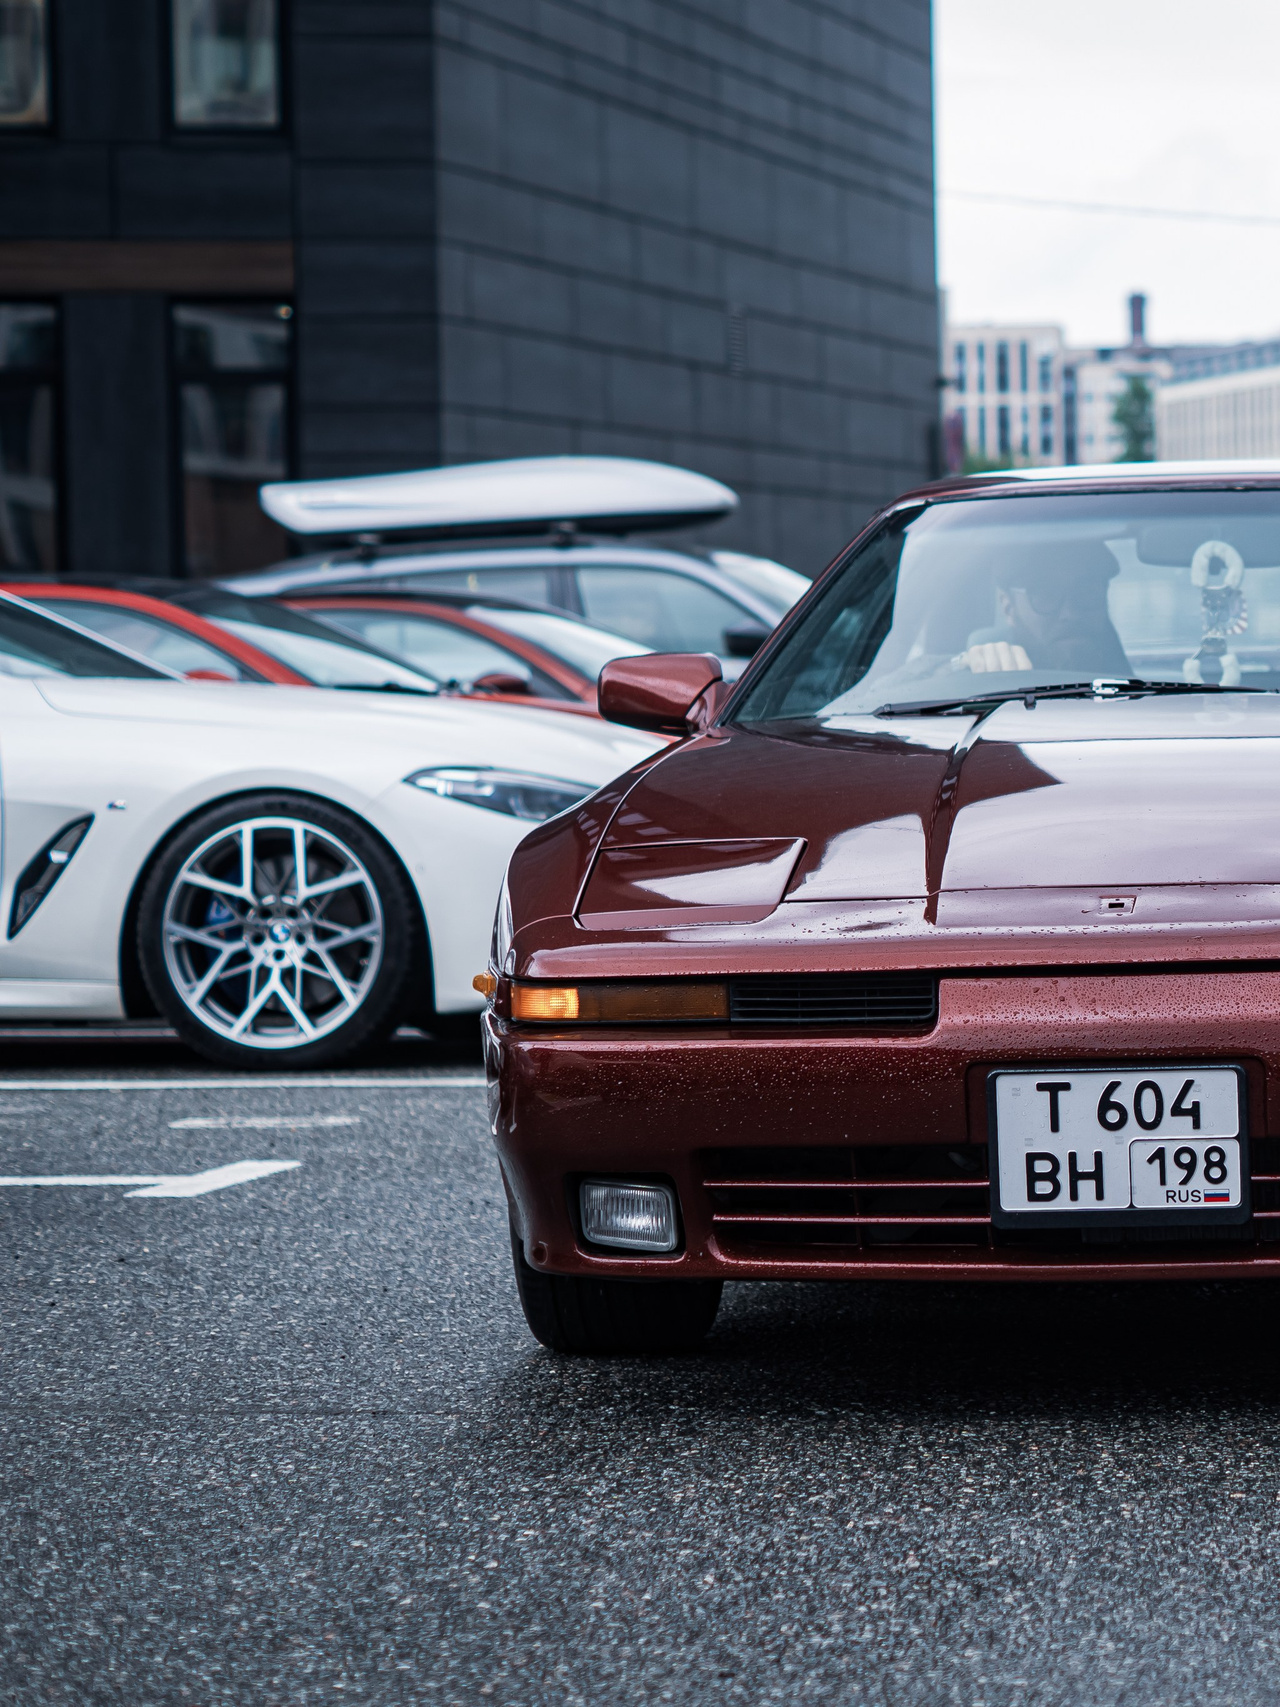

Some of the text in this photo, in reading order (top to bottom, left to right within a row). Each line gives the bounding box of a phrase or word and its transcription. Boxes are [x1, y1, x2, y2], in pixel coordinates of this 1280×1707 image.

[1097, 1079, 1201, 1131] 604
[1146, 1145, 1228, 1186] 198
[1165, 1189, 1202, 1203] RUS
